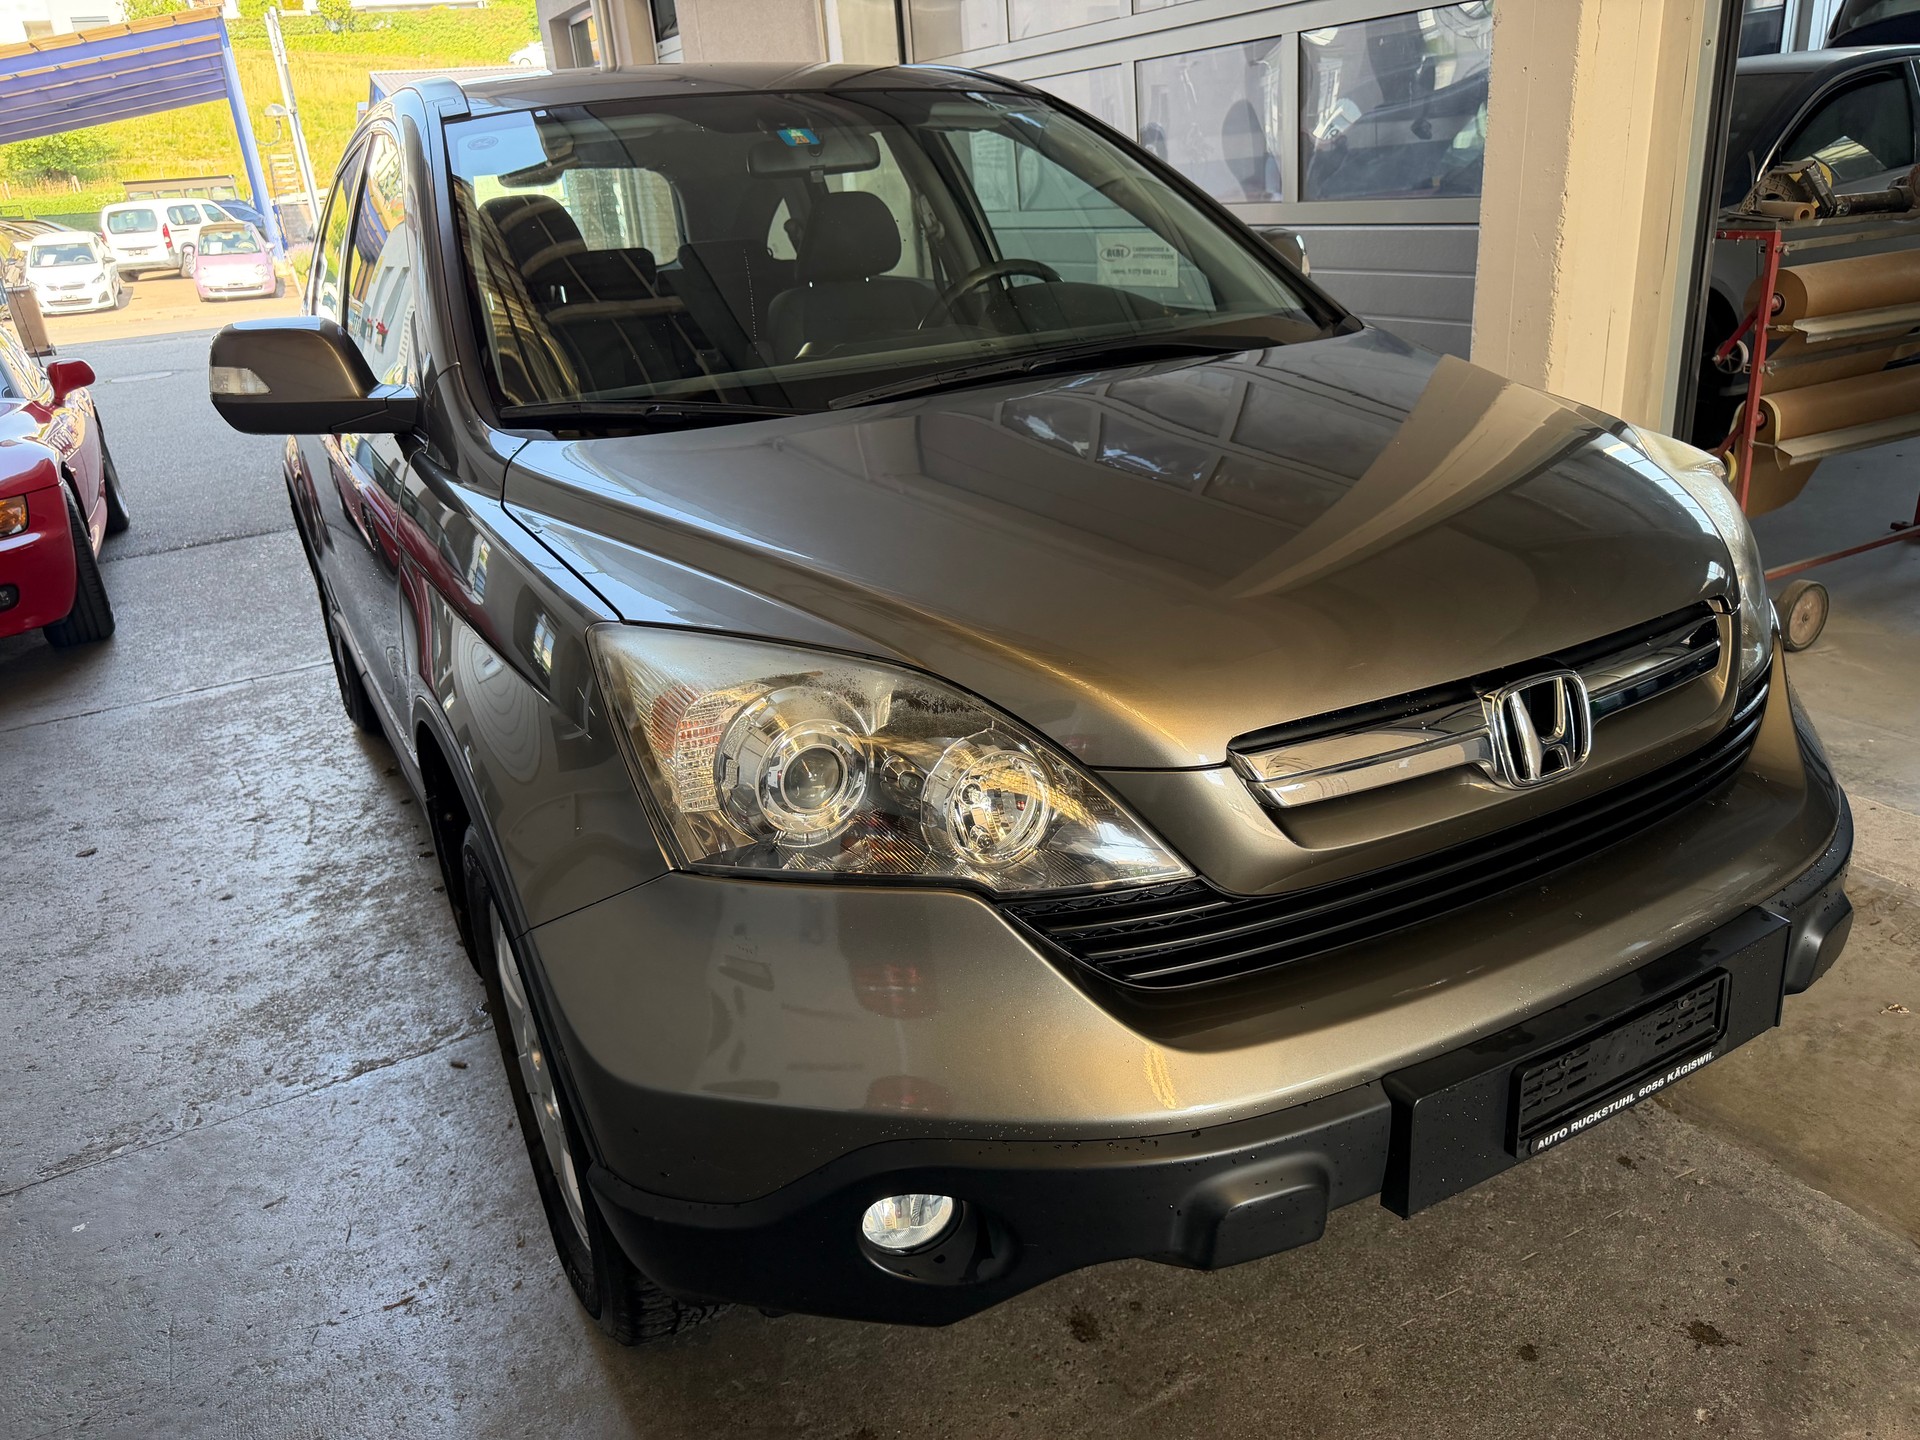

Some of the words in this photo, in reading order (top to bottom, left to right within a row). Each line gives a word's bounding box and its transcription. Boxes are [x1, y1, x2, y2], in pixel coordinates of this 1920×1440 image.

[1537, 1127, 1568, 1150] AUTO
[1571, 1093, 1636, 1133] RUCKSTUHL
[1638, 1078, 1664, 1098] 6056
[1666, 1051, 1715, 1083] KÄGISWIL
